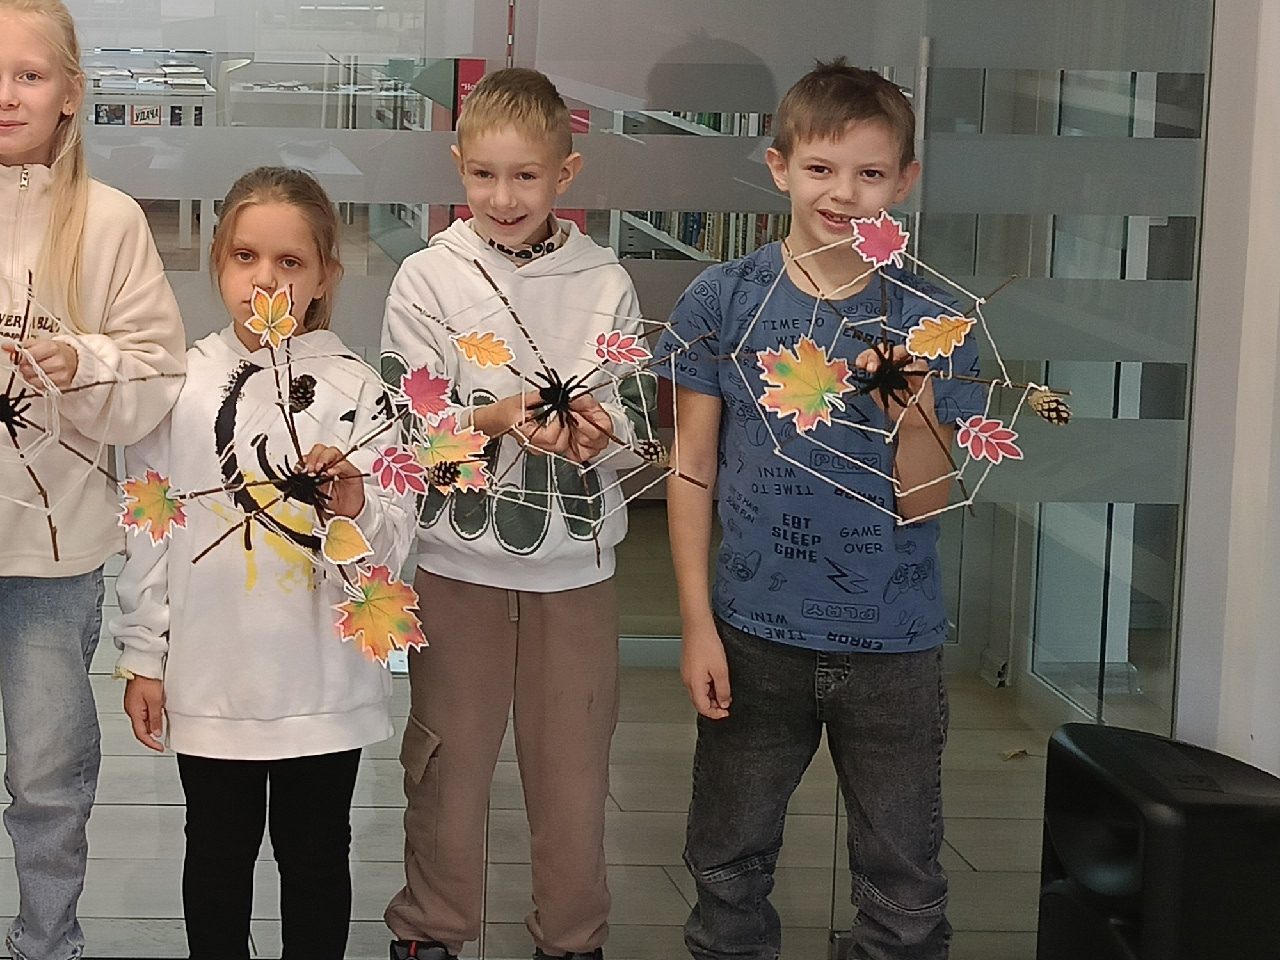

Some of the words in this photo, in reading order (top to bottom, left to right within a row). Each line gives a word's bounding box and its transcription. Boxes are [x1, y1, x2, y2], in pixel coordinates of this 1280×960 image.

[762, 318, 800, 331] TIME
[806, 316, 825, 328] TO
[774, 483, 815, 496] TIME
[782, 512, 812, 530] EAT
[771, 525, 821, 547] SLEEP
[839, 524, 882, 539] GAME
[773, 542, 818, 563] GAME
[843, 542, 884, 555] OVER
[806, 602, 877, 621] PLAY
[826, 631, 884, 651] ERROR
